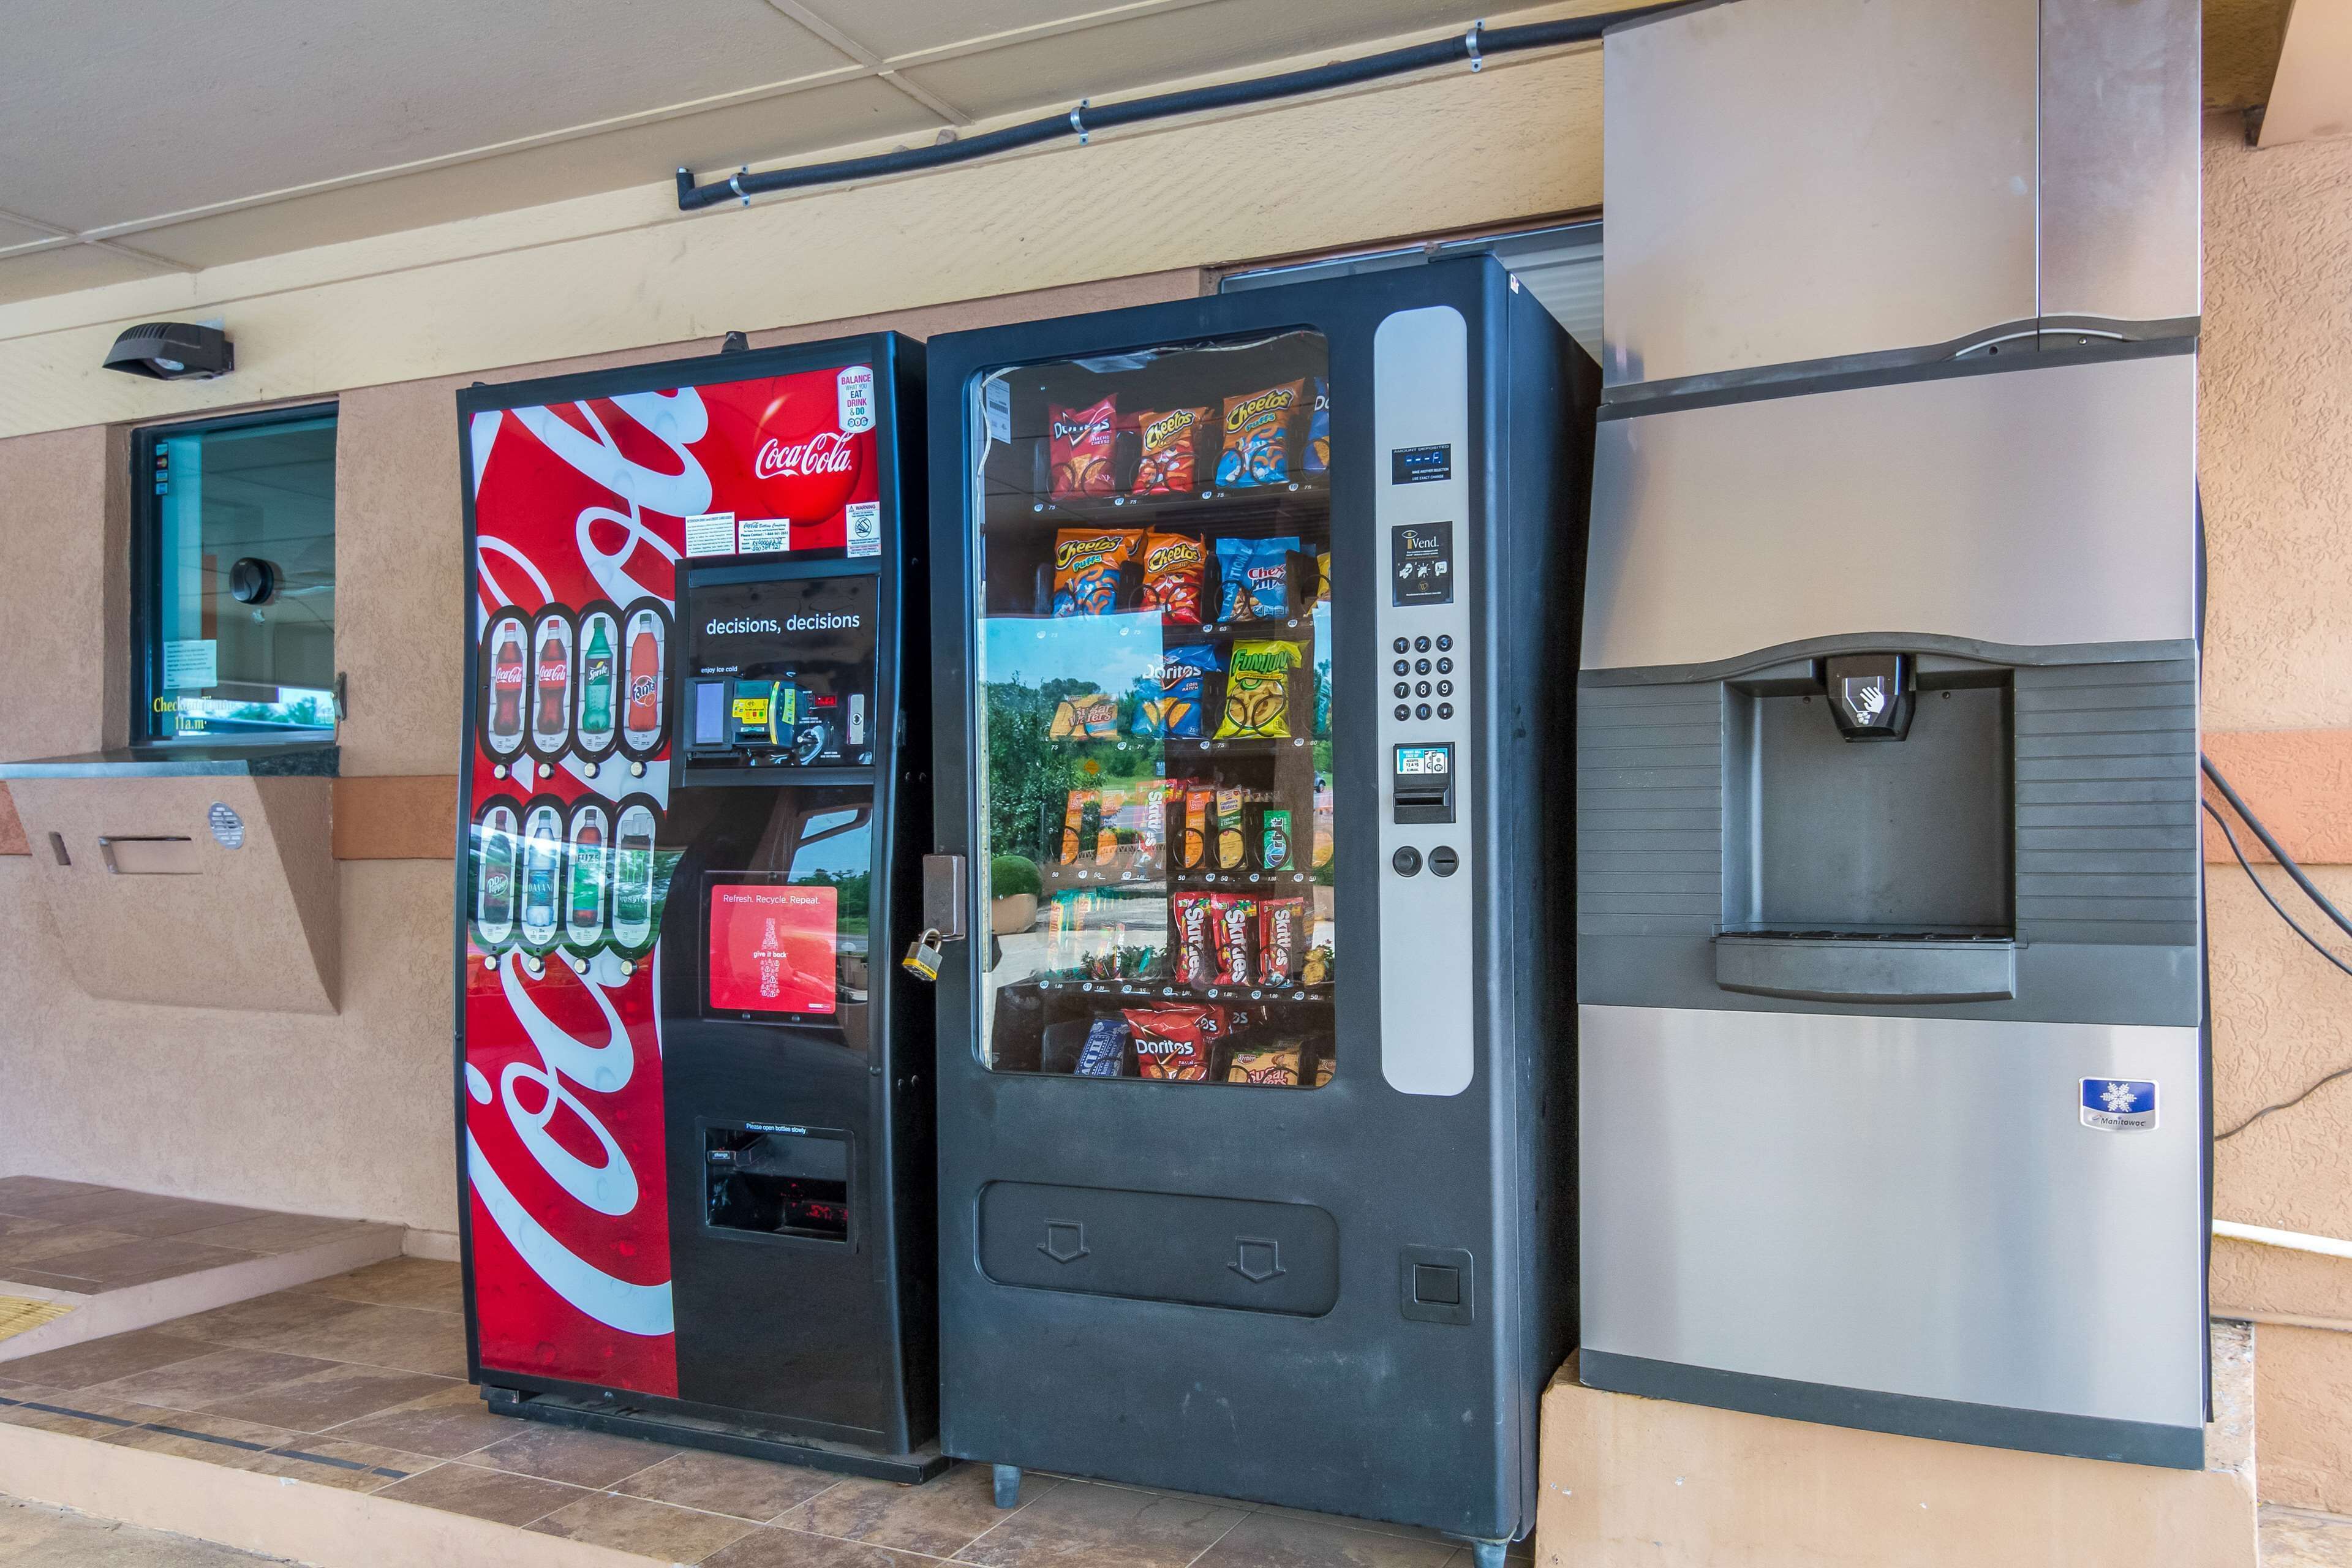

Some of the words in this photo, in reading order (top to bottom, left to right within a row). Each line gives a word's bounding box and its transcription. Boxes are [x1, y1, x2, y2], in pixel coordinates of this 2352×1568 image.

[842, 374, 871, 385] BALANCE
[847, 398, 867, 407] DRINK
[851, 390, 862, 399] EAT
[856, 407, 865, 415] DO
[1227, 390, 1292, 432] Cheetos
[1145, 410, 1194, 450] Cheetos
[1245, 413, 1276, 432] Puffs
[755, 432, 854, 480] Coca-Cola
[1057, 537, 1121, 569] Cheetos
[1148, 543, 1200, 572] Cheetos
[1073, 555, 1102, 572] Puffs
[1248, 565, 1286, 579] Chex
[707, 617, 782, 635] decisions,
[786, 613, 860, 631] decisions
[1399, 640, 1403, 650] 1
[1419, 639, 1426, 649] 2
[1441, 638, 1448, 648] 3
[496, 666, 522, 683] Coca-Cola
[540, 664, 566, 681] Coca-Cola
[589, 665, 608, 681] Sprite
[1142, 663, 1202, 679] Doritos
[1421, 662, 1427, 673] 5
[1441, 660, 1448, 671] 6
[632, 680, 655, 703] Fanta
[1400, 685, 1404, 696] 7
[1420, 684, 1426, 695] 8
[1442, 683, 1448, 693] 9
[1421, 707, 1427, 717] 0
[1145, 791, 1163, 847] Skittles
[578, 853, 598, 862] FUZE
[756, 895, 788, 905] Recycle.
[790, 895, 820, 905] Repeat.
[1185, 907, 1204, 981] Skittles
[1275, 909, 1291, 966] Skittles
[1225, 910, 1246, 982] Skittles
[1136, 1039, 1194, 1055] Doritos
[2101, 1118, 2146, 1126] Manitowoc
